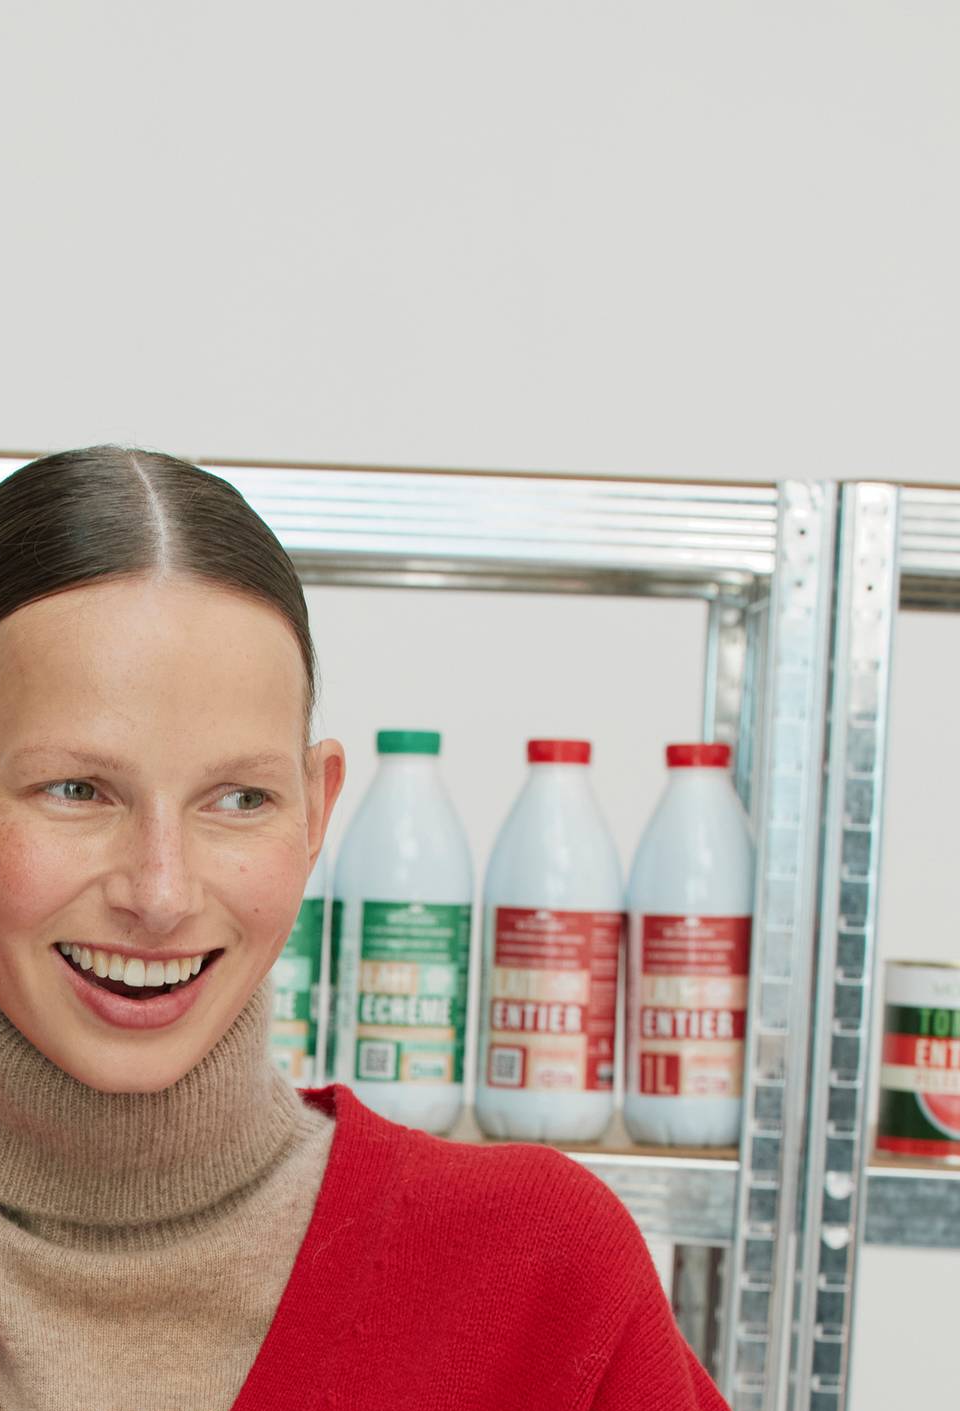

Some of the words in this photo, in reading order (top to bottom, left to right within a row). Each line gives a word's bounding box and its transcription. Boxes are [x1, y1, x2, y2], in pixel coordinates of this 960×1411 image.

[493, 1003, 581, 1032] ENTIER
[643, 1009, 733, 1039] ENTIER
[920, 1007, 960, 1037] TO
